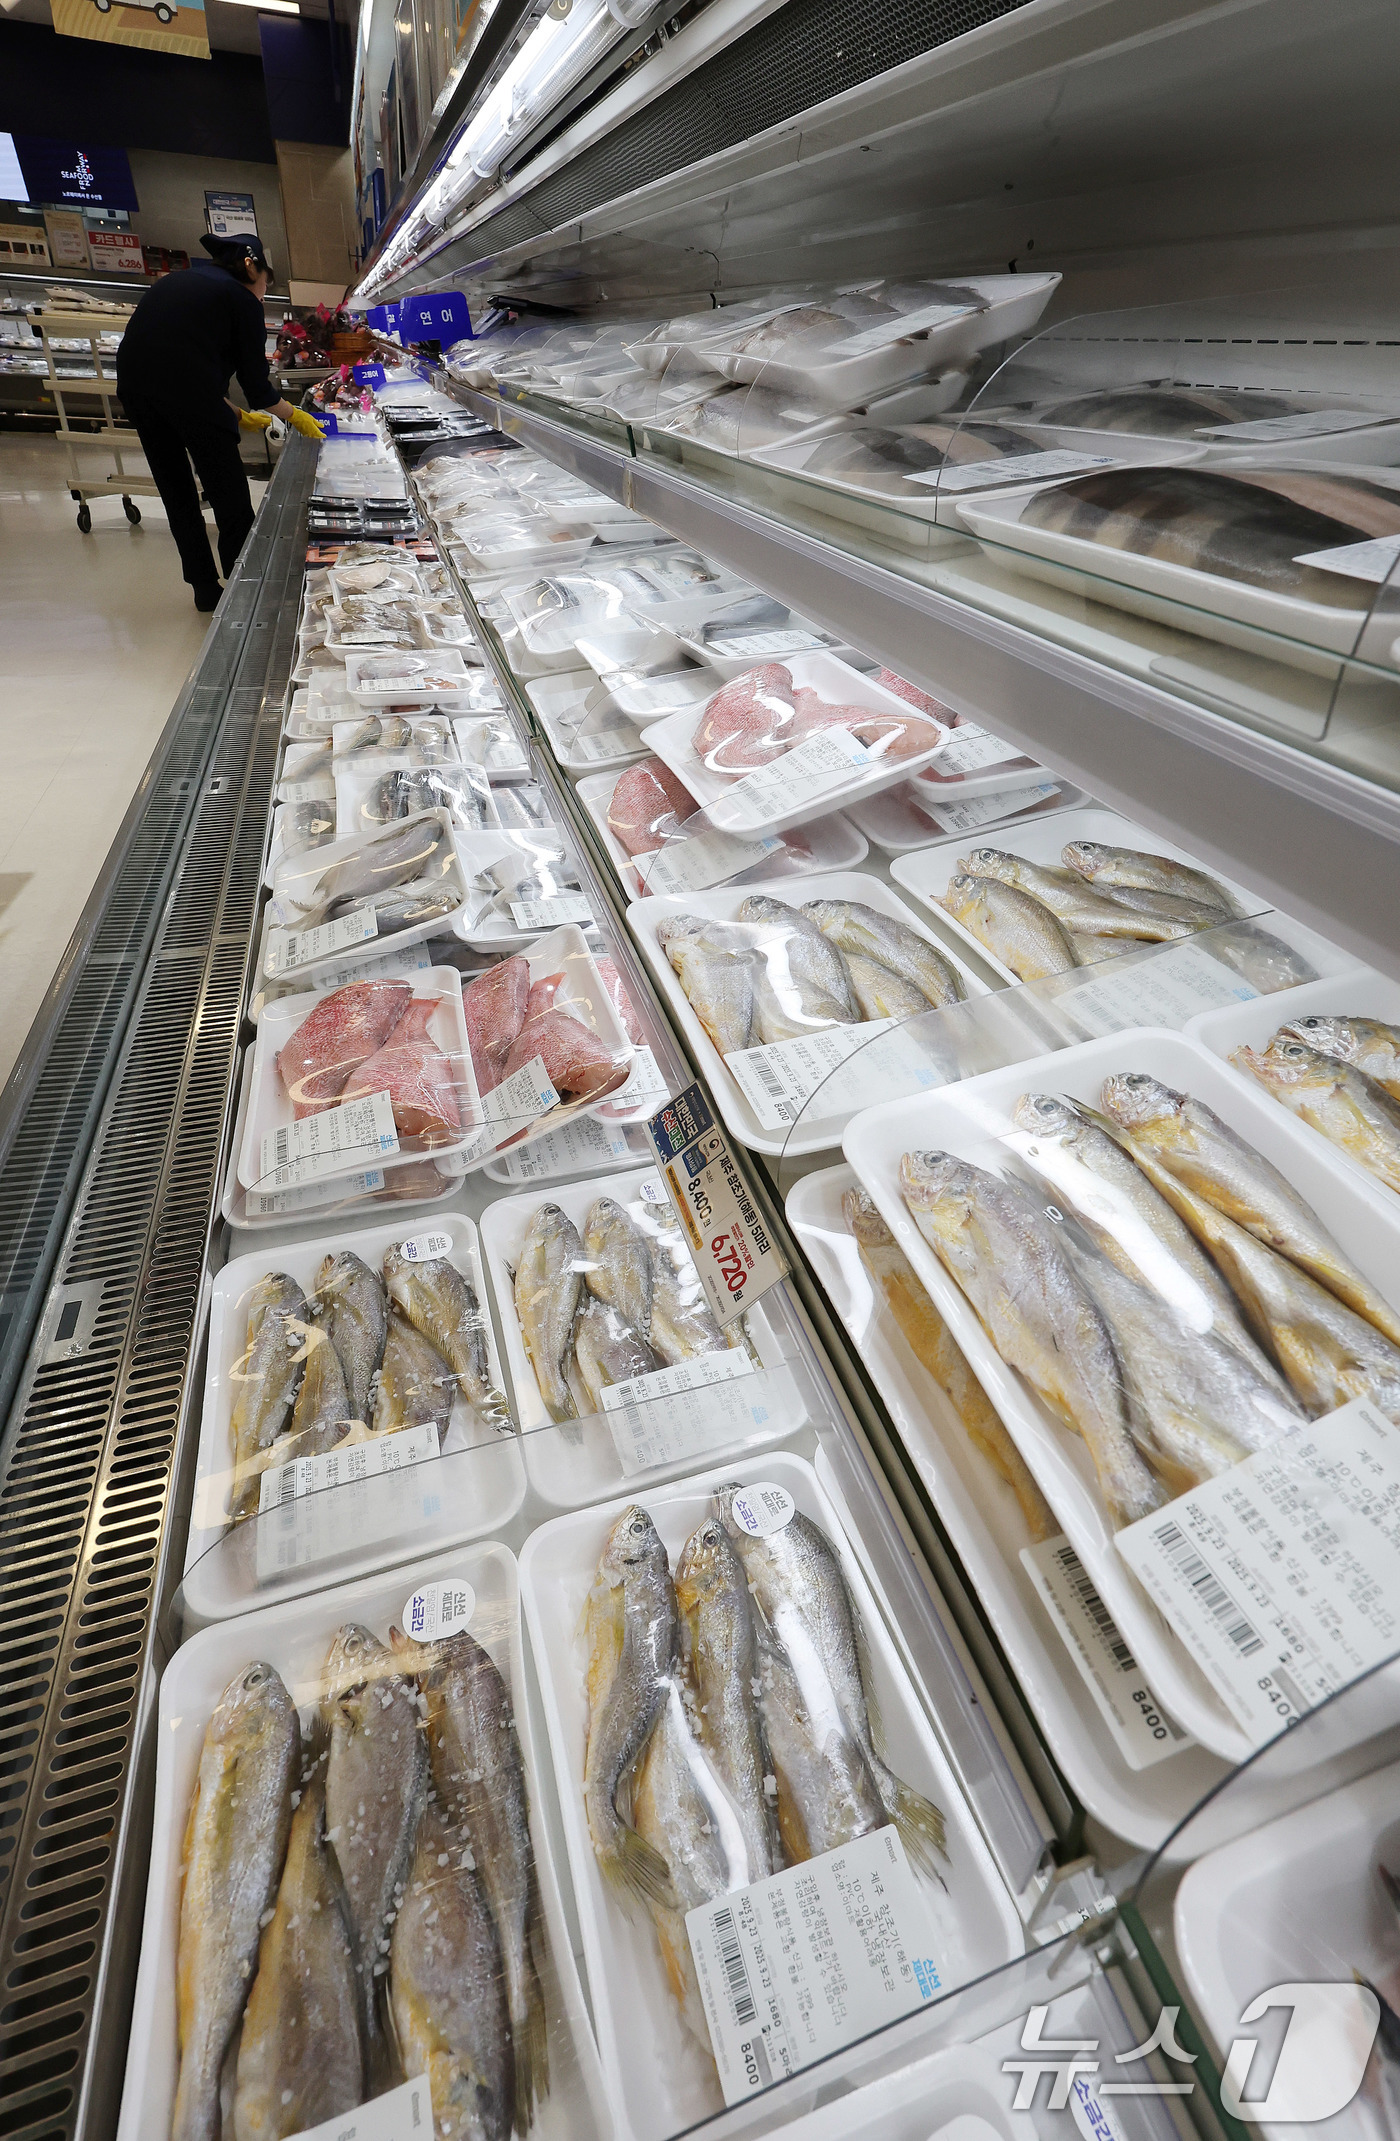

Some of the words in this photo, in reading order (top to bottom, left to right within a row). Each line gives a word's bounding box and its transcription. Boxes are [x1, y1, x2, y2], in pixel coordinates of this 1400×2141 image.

[61, 171, 93, 180] SEAFOOD
[118, 259, 142, 269] 6,286
[362, 370, 378, 378] 고등어
[674, 1096, 699, 1140] 대한민국
[773, 1101, 789, 1121] 8400
[660, 1108, 686, 1152] 수산대전
[274, 1168, 282, 1184] 10960
[720, 1154, 734, 1176] 제주
[259, 1197, 267, 1212] 10960
[643, 1183, 656, 1200] 소금간
[726, 1172, 758, 1228] 참조기(해동)
[406, 1241, 417, 1258] 소금간
[435, 1236, 446, 1248] 신선
[751, 1226, 772, 1256] 5마리
[1358, 1408, 1388, 1439] emart
[735, 1499, 758, 1530] 소금간
[760, 1491, 779, 1516] 제대로
[770, 1490, 788, 1509] 신선
[1185, 1502, 1227, 1551] 2025.9.23
[1273, 1617, 1305, 1655] 1680
[411, 1595, 423, 1632] 소금간
[441, 1591, 452, 1622] 제대로
[452, 1591, 466, 1616] 신선
[1131, 1688, 1167, 1740] 8400
[883, 1836, 898, 1863] emart
[868, 1870, 885, 1897] 제주
[737, 1910, 747, 1929] 8:48
[870, 1909, 892, 1950] 국내산
[850, 1878, 875, 1930] 10℃이하
[869, 1936, 895, 1993] 냉장보관
[739, 1895, 758, 1937] 2025.9.23
[752, 1944, 772, 1989] 2025.9.23
[767, 1998, 782, 2027] 1680
[922, 1957, 941, 1990] 신선
[791, 1950, 805, 1972] 신고
[801, 1987, 815, 2009] 1399
[910, 1958, 931, 1999] 제대로
[739, 2041, 761, 2085] 8400
